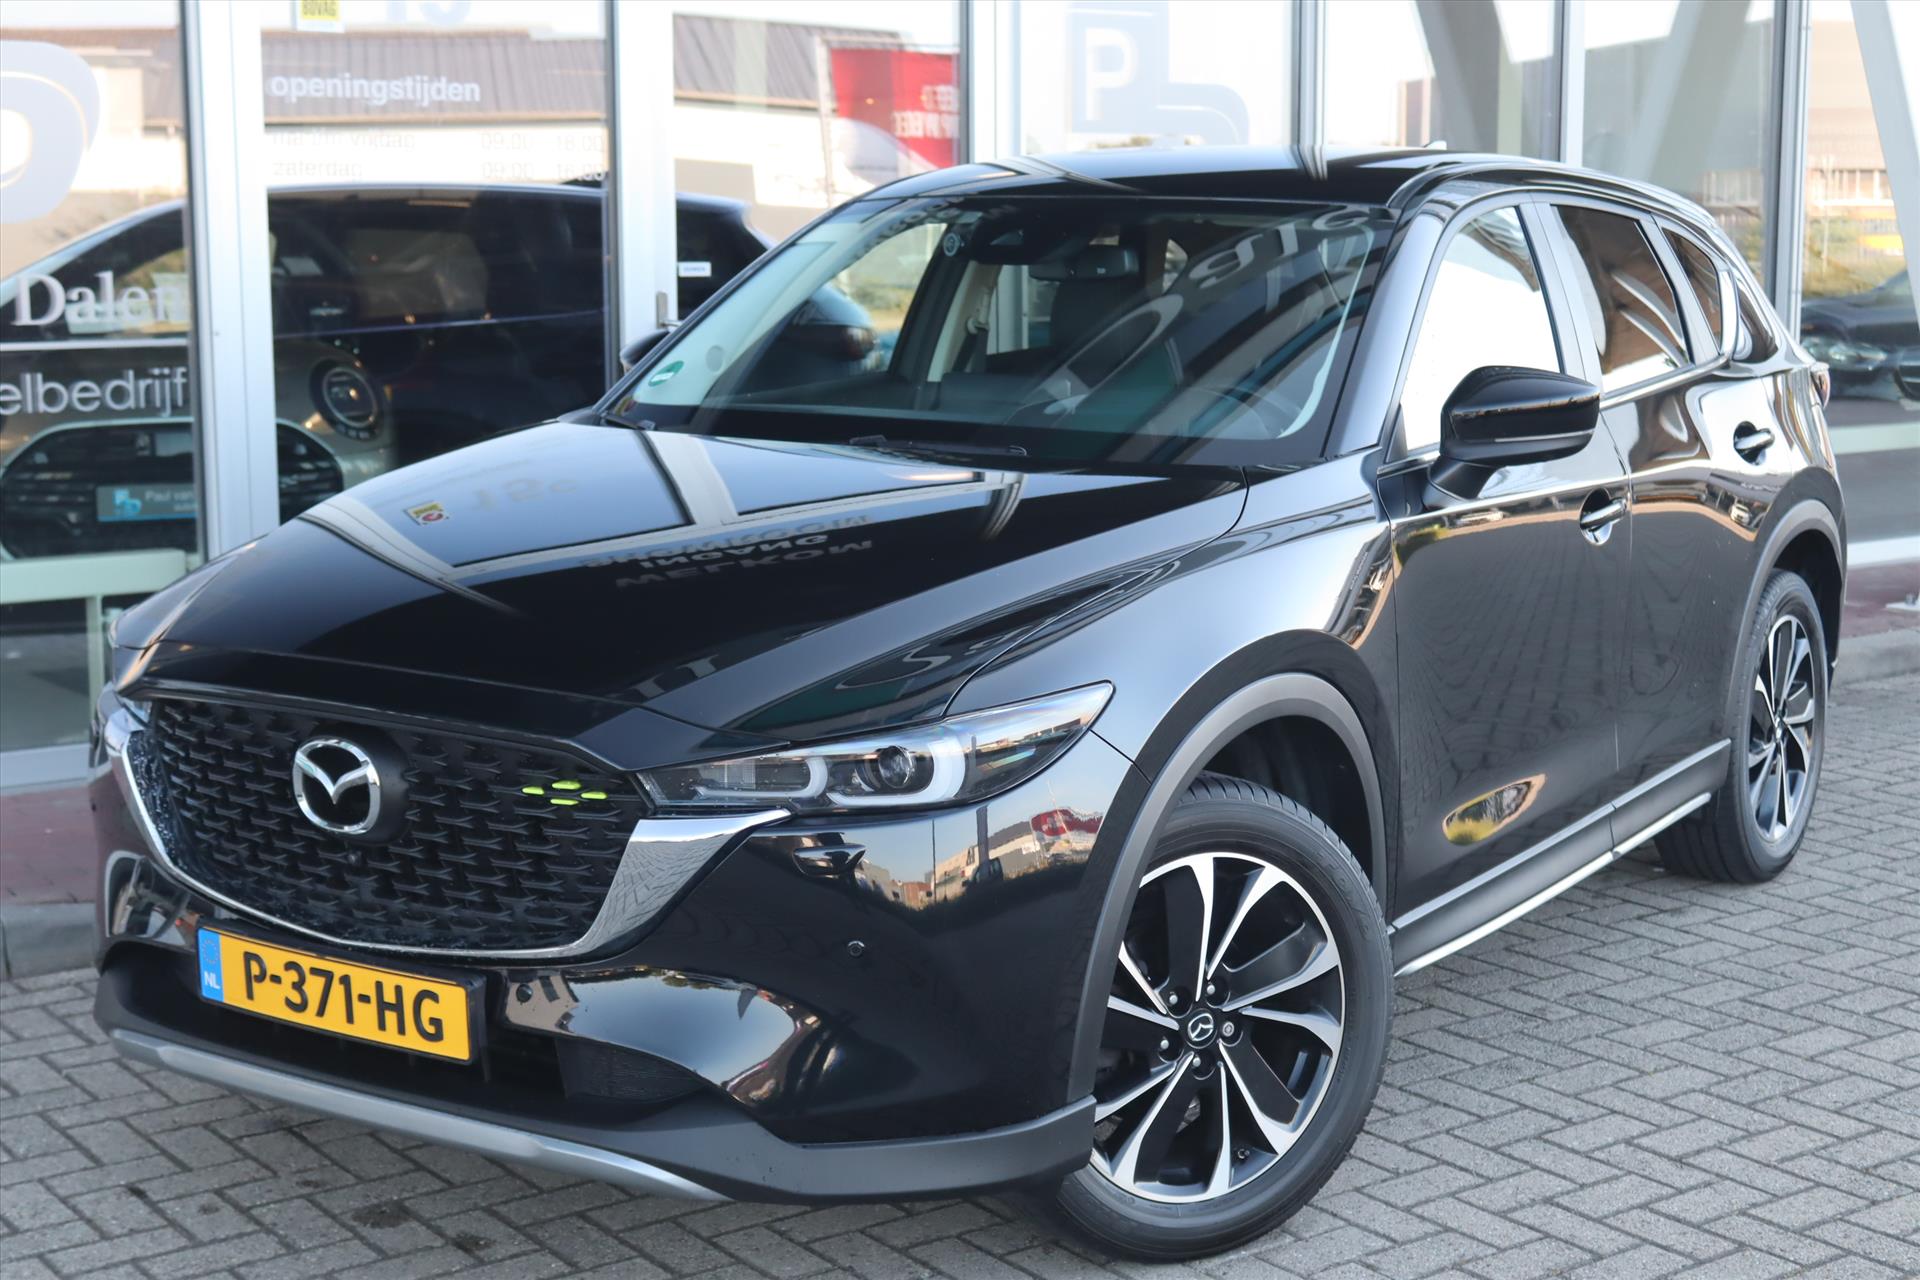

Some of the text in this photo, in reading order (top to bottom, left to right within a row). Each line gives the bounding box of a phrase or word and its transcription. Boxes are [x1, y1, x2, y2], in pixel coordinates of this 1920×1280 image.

[270, 72, 481, 107] openingstijden
[204, 970, 220, 990] NL
[243, 950, 444, 1043] P-371-HG
